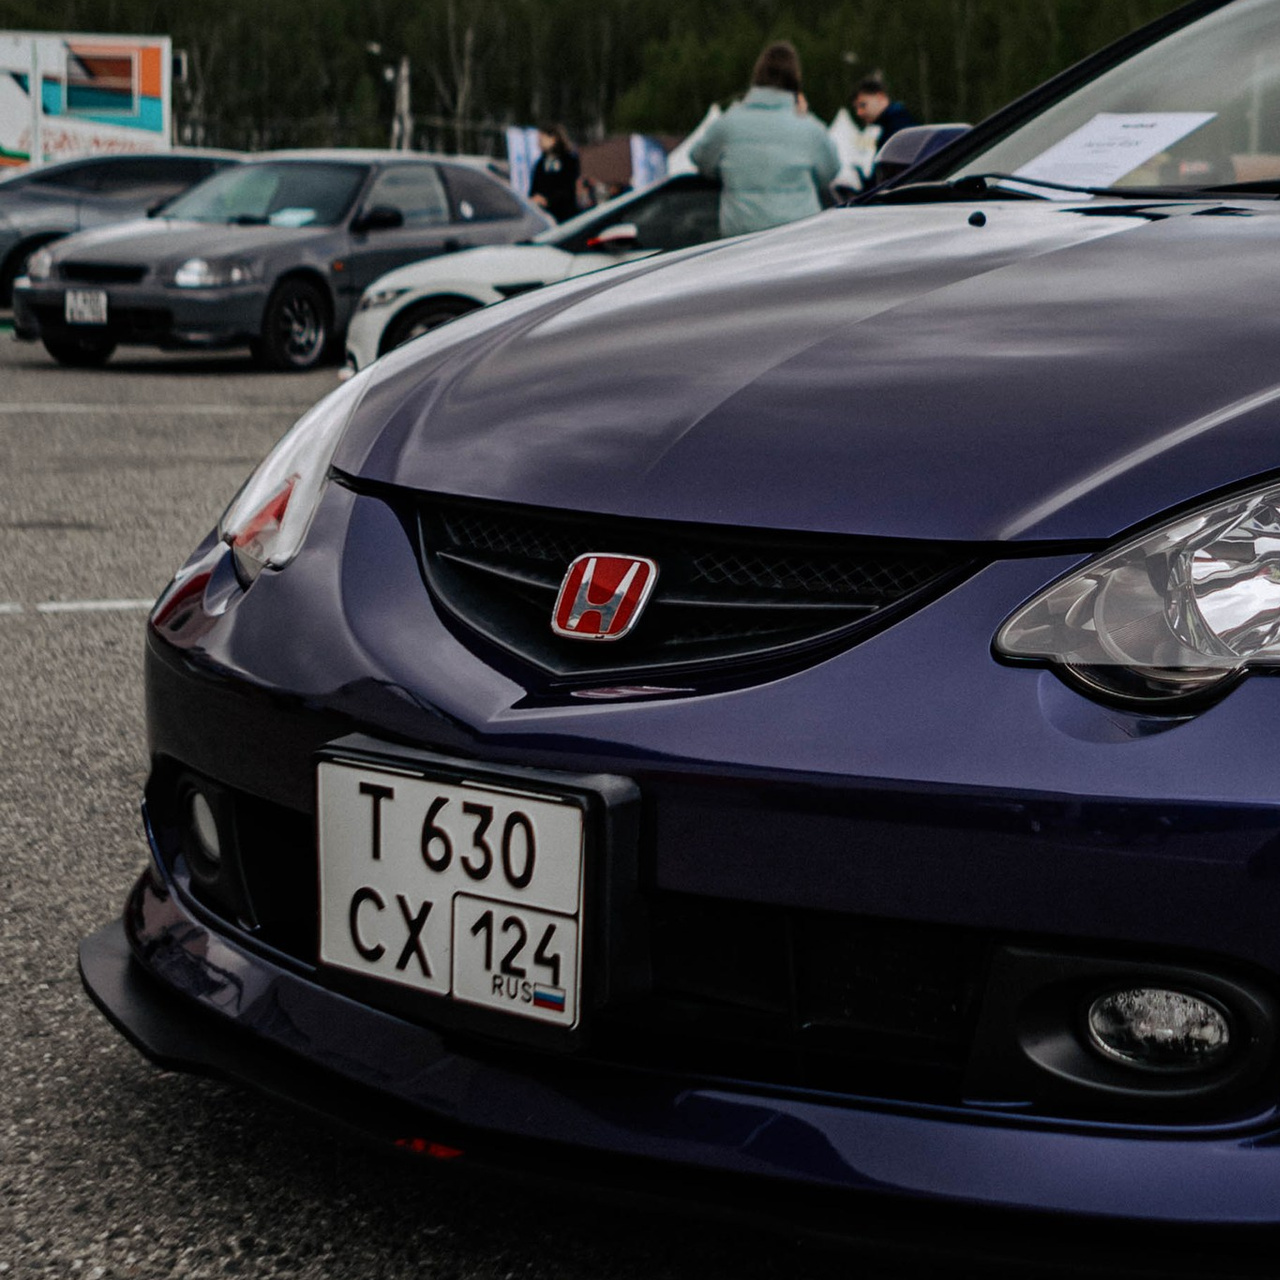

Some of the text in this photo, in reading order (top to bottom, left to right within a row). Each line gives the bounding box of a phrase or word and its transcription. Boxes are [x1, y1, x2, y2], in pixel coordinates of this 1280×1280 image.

[420, 796, 536, 890] 630
[470, 910, 561, 986] 124
[492, 974, 533, 1004] RUS
